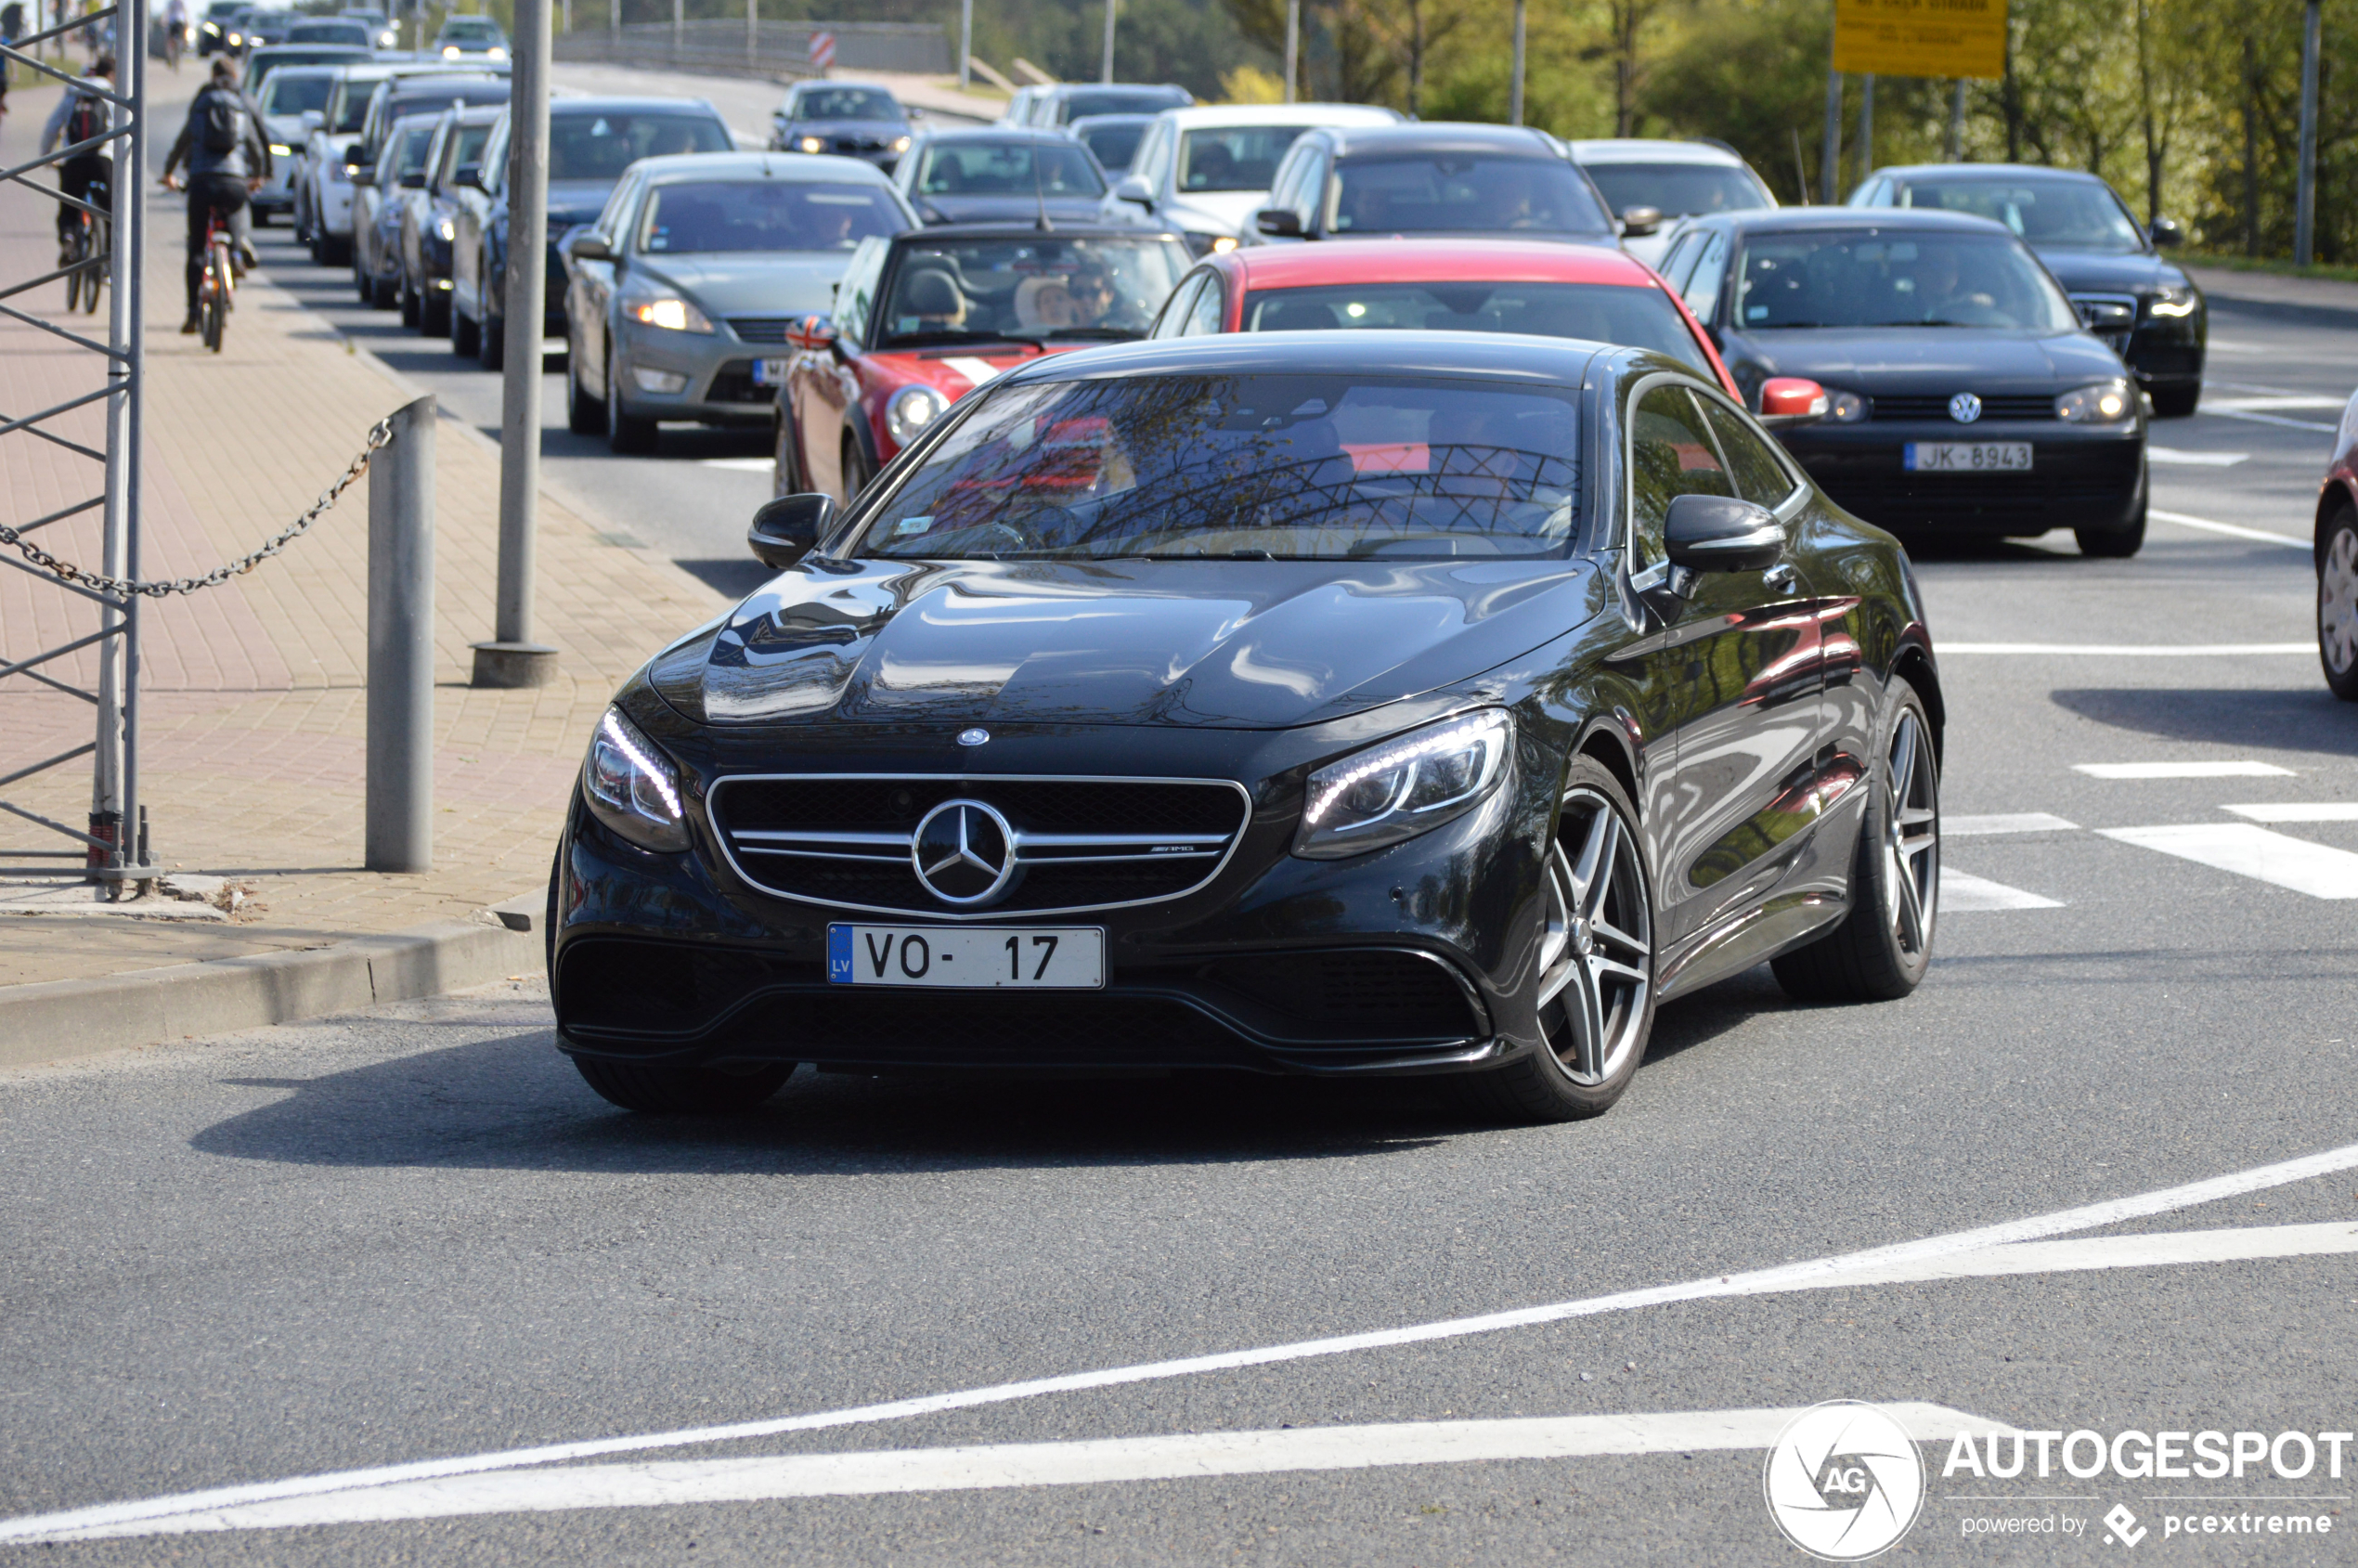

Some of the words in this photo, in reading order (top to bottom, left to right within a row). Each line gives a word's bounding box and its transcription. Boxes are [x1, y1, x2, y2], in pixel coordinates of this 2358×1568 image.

[1923, 447, 2029, 468] JK-8943
[832, 959, 849, 973] LV
[1005, 936, 1058, 980] 17
